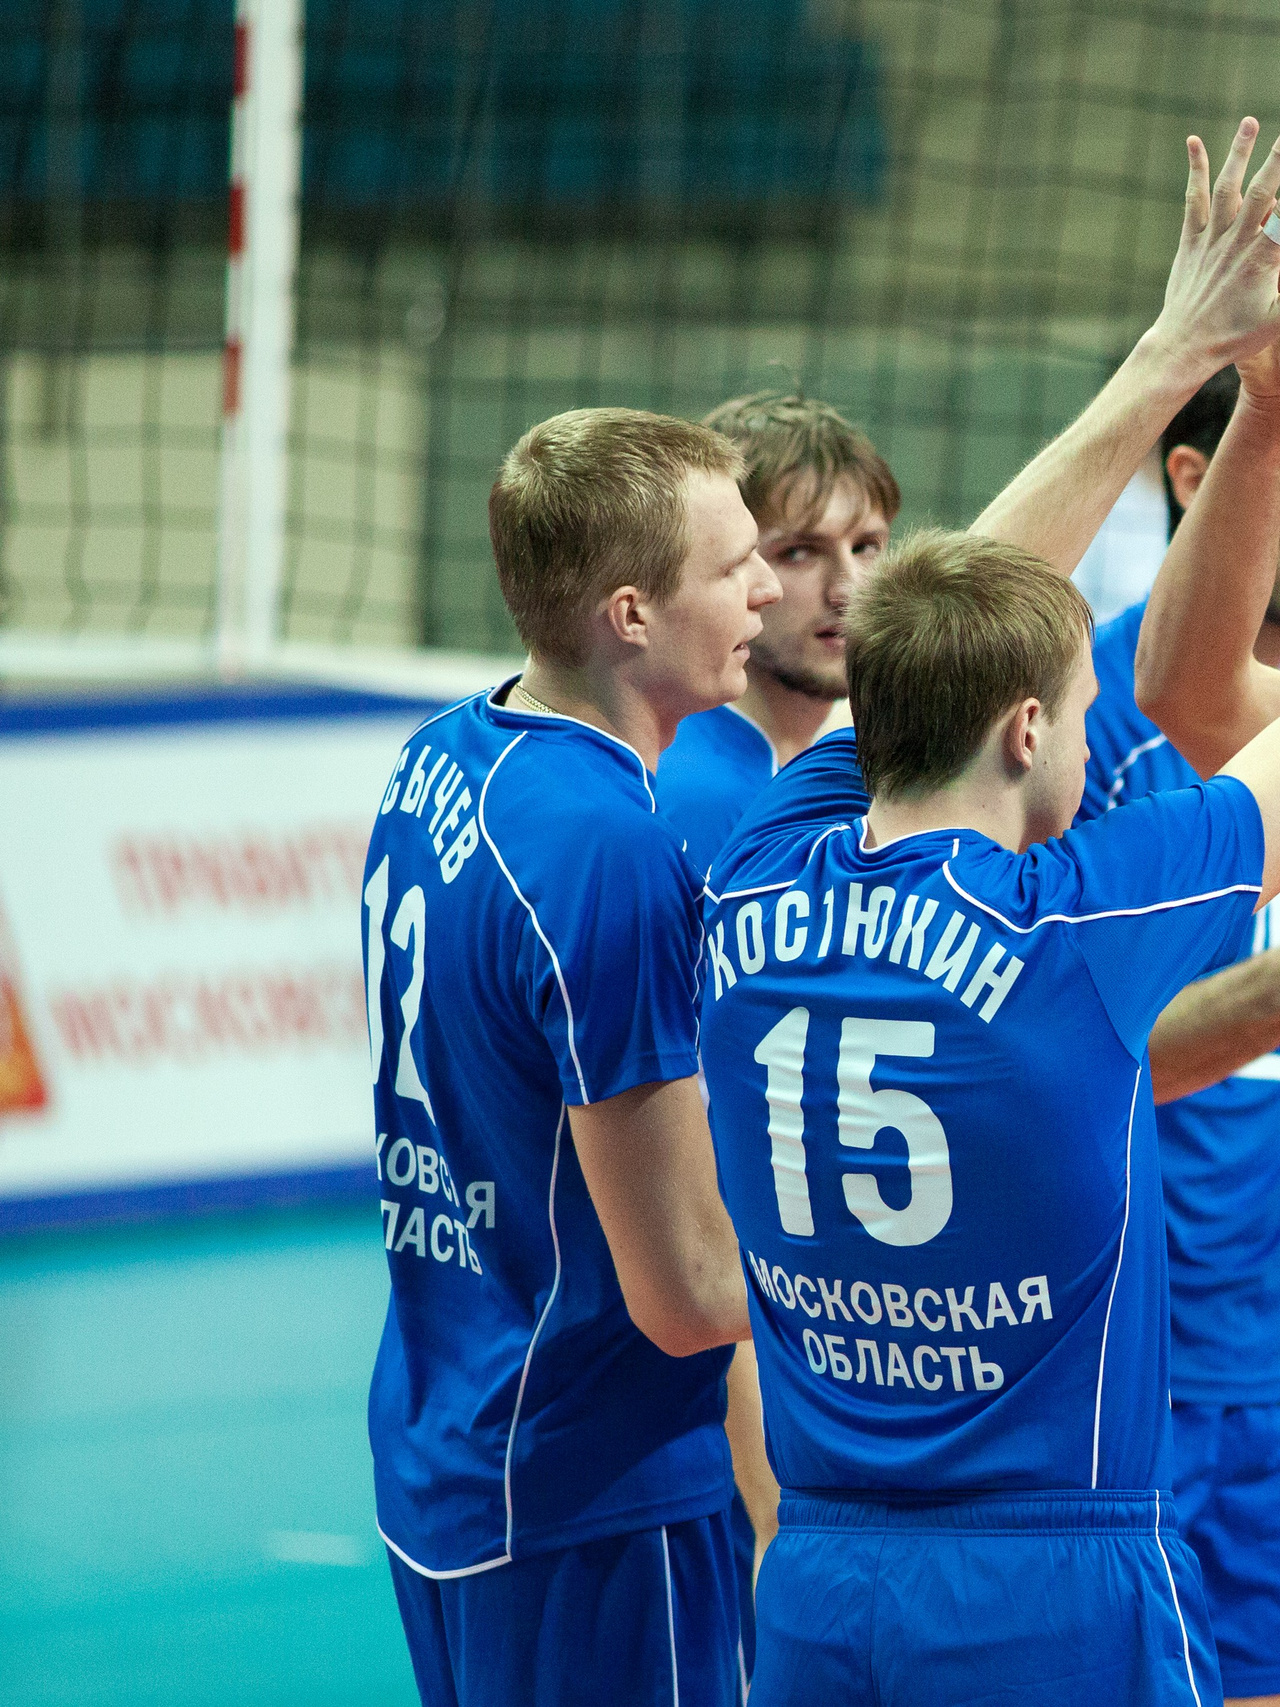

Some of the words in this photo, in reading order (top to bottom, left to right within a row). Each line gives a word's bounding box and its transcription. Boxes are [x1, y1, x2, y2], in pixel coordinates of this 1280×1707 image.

[381, 744, 479, 884] СЫЧЕВ
[364, 854, 436, 1127] 12
[754, 1006, 953, 1246] 15
[748, 1250, 1053, 1332] МОСКОВСКАЯ
[802, 1328, 1004, 1391] ОБЛАСТЬ
